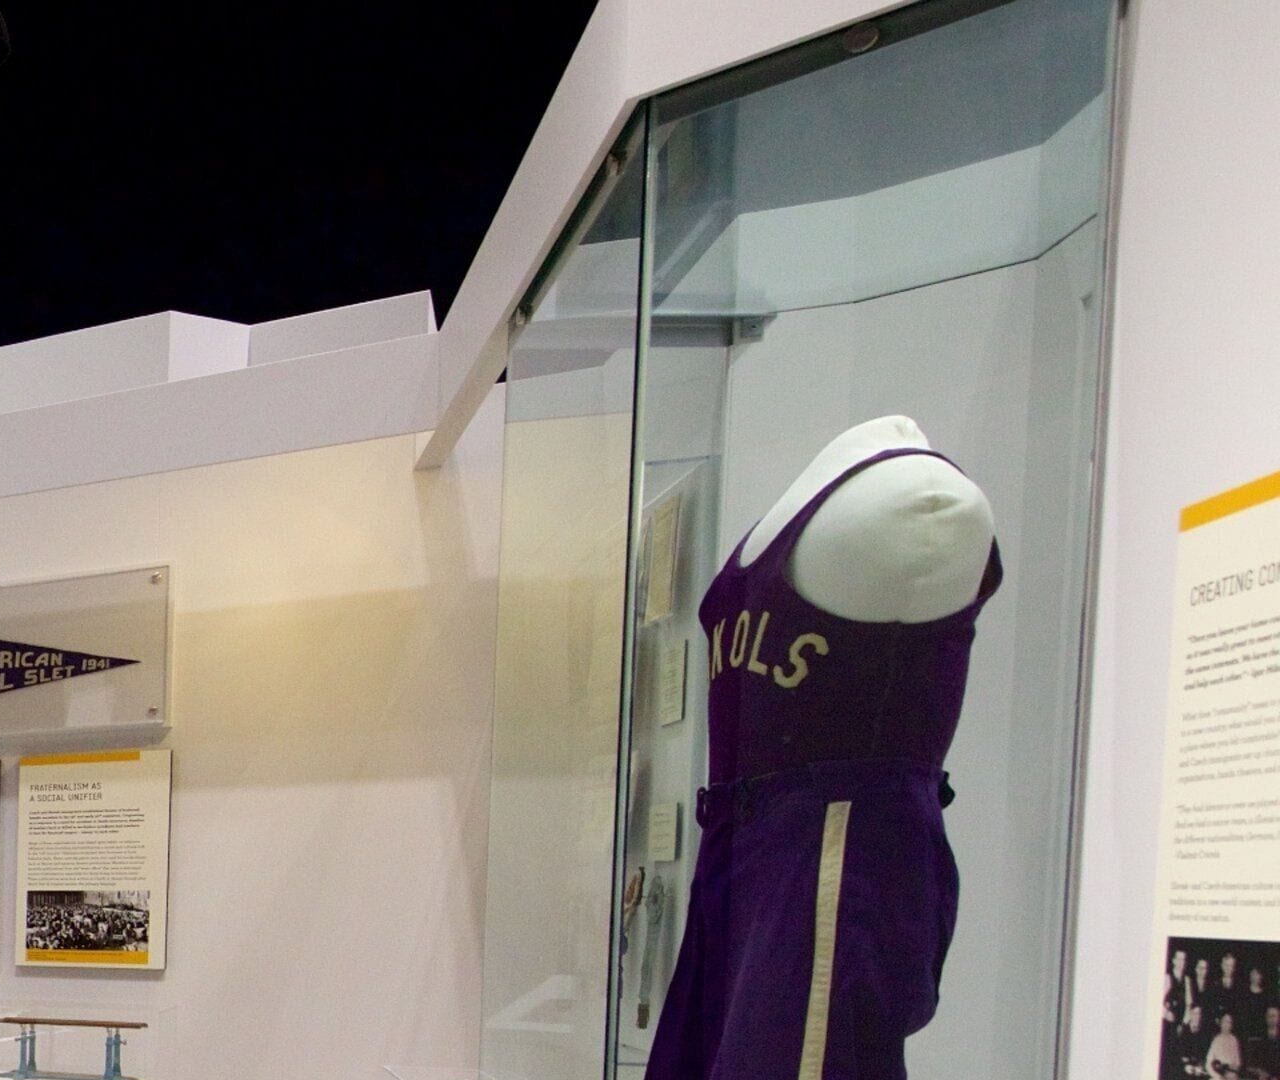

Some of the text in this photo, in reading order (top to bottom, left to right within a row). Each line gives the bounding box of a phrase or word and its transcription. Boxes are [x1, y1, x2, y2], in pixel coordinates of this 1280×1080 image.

[1190, 569, 1254, 606] CREATING
[23, 665, 75, 686] SLET
[81, 659, 111, 671] 1941
[29, 782, 102, 792] FRATERNALISM AS
[37, 793, 66, 802] SOCIAL
[68, 792, 103, 801] UNIFIER
